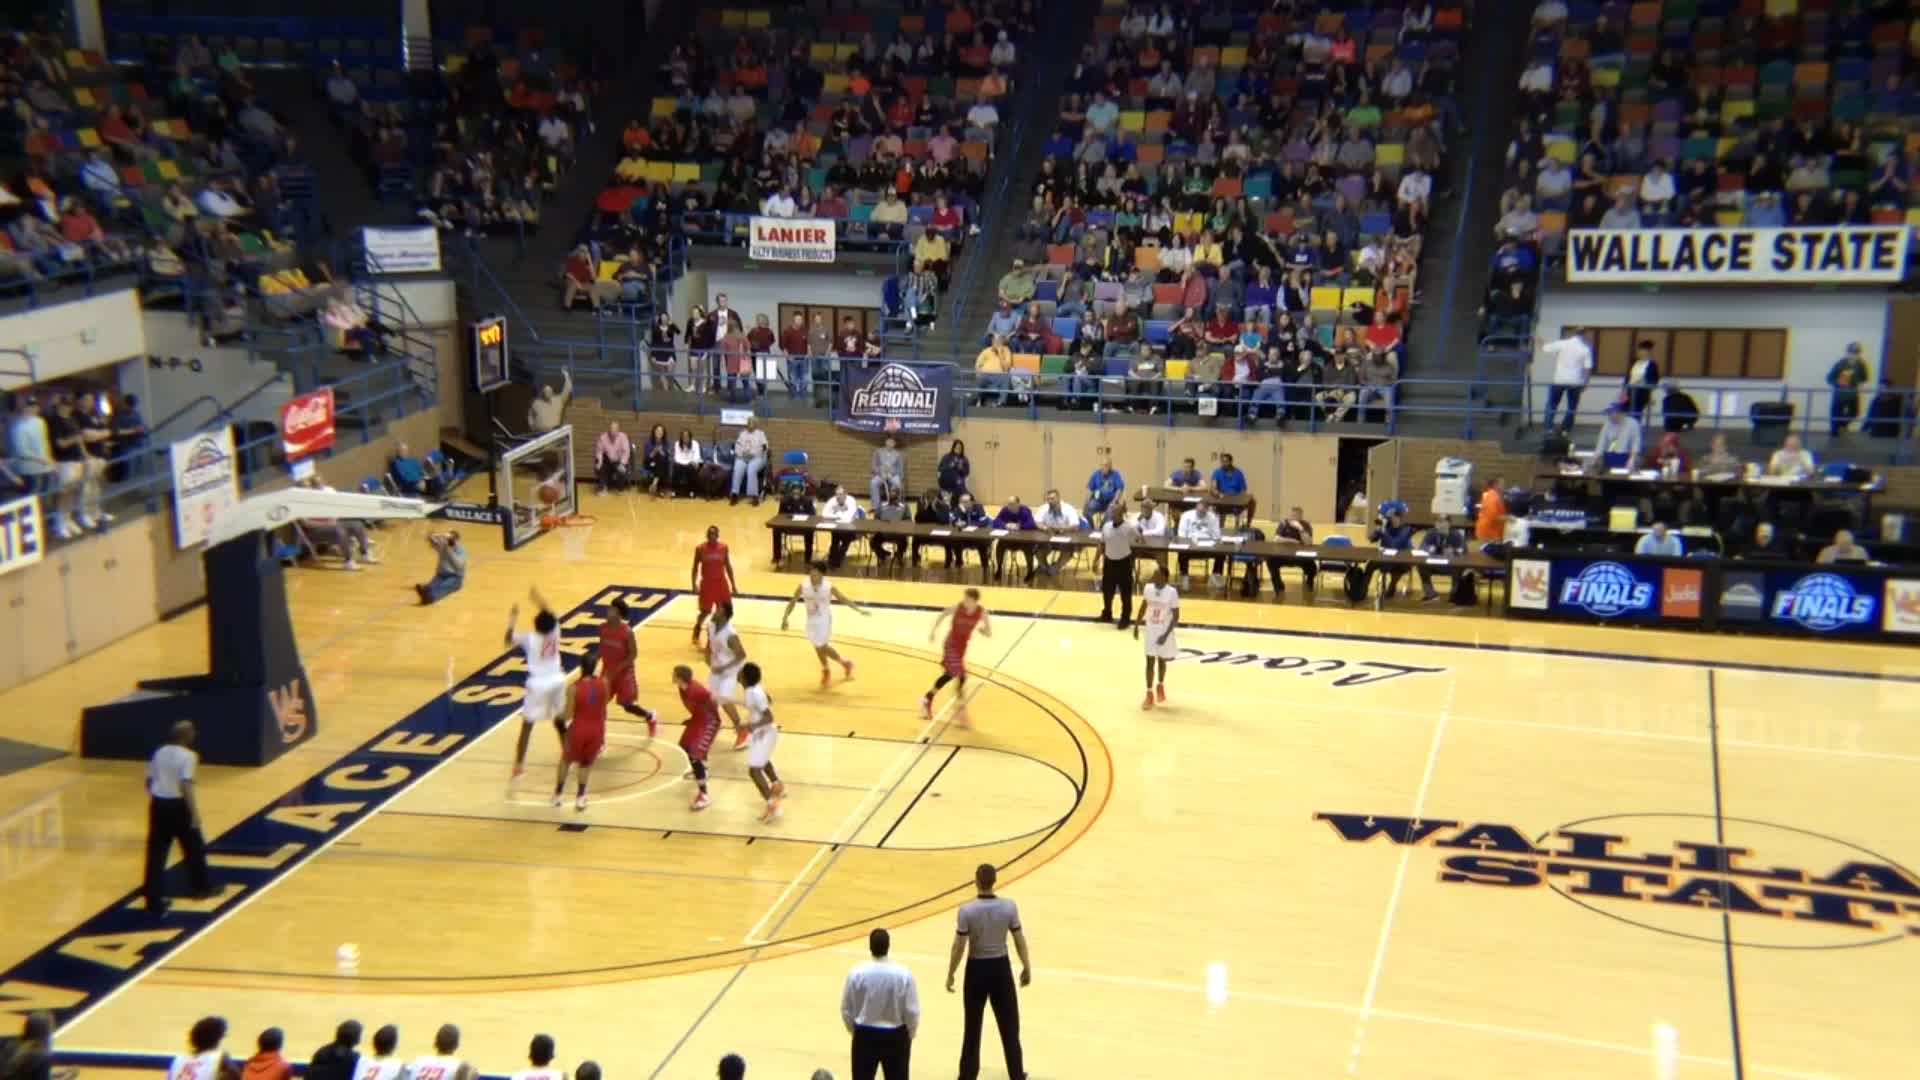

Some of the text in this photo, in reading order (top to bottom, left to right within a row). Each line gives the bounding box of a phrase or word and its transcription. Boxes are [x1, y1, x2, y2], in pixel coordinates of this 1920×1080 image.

[757, 226, 827, 243] LANIER
[1573, 232, 1902, 273] WALLACE STATE
[857, 391, 933, 409] REGIONAL
[446, 508, 493, 522] WALLACE
[0, 503, 37, 565] TE
[1561, 580, 1654, 607] FINALS
[1774, 593, 1874, 621] FINALS
